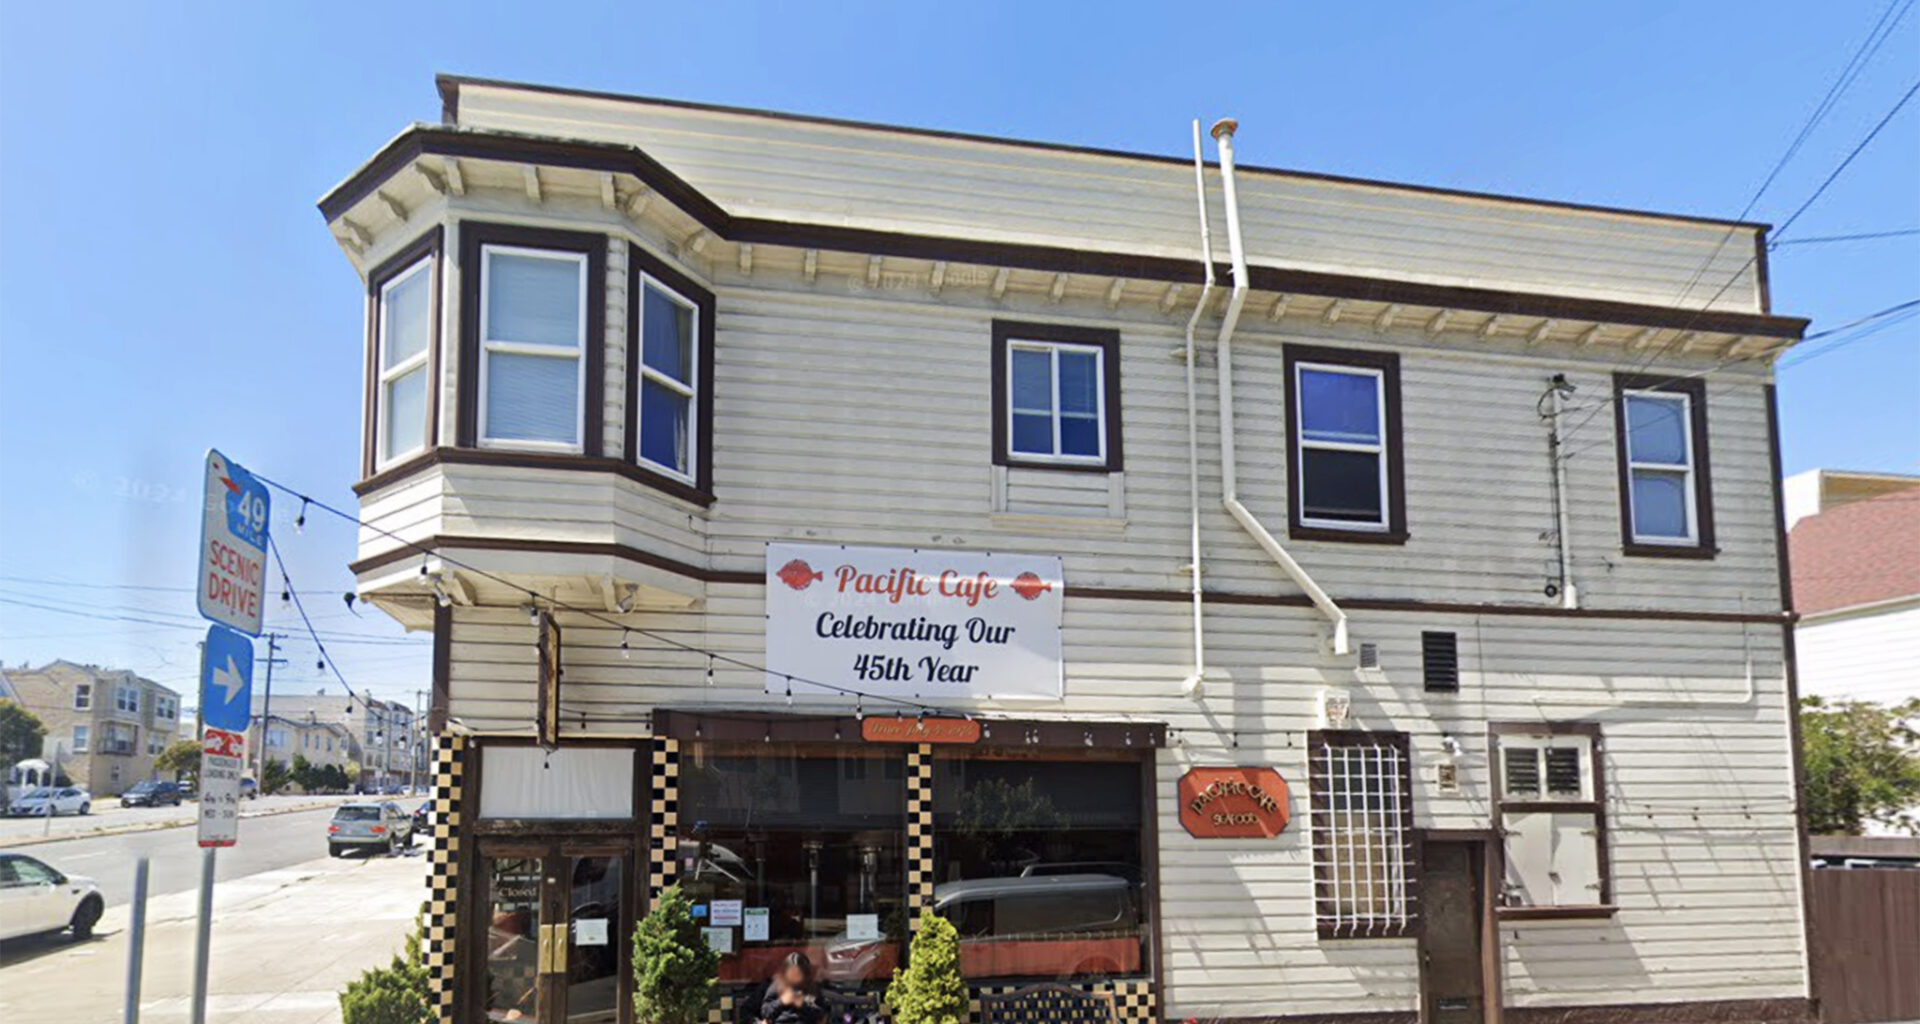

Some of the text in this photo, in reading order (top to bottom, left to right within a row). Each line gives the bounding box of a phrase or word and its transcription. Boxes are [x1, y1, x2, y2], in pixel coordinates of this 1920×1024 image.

[238, 489, 265, 533] 49
[236, 521, 263, 548] MILE
[210, 540, 259, 587] SCENIC
[208, 572, 256, 619] DRIVE
[834, 564, 999, 607] Pacific Cafe
[816, 611, 1015, 650] Celebrating Our
[853, 654, 979, 684] 45th Year
[499, 887, 537, 898] Closed
